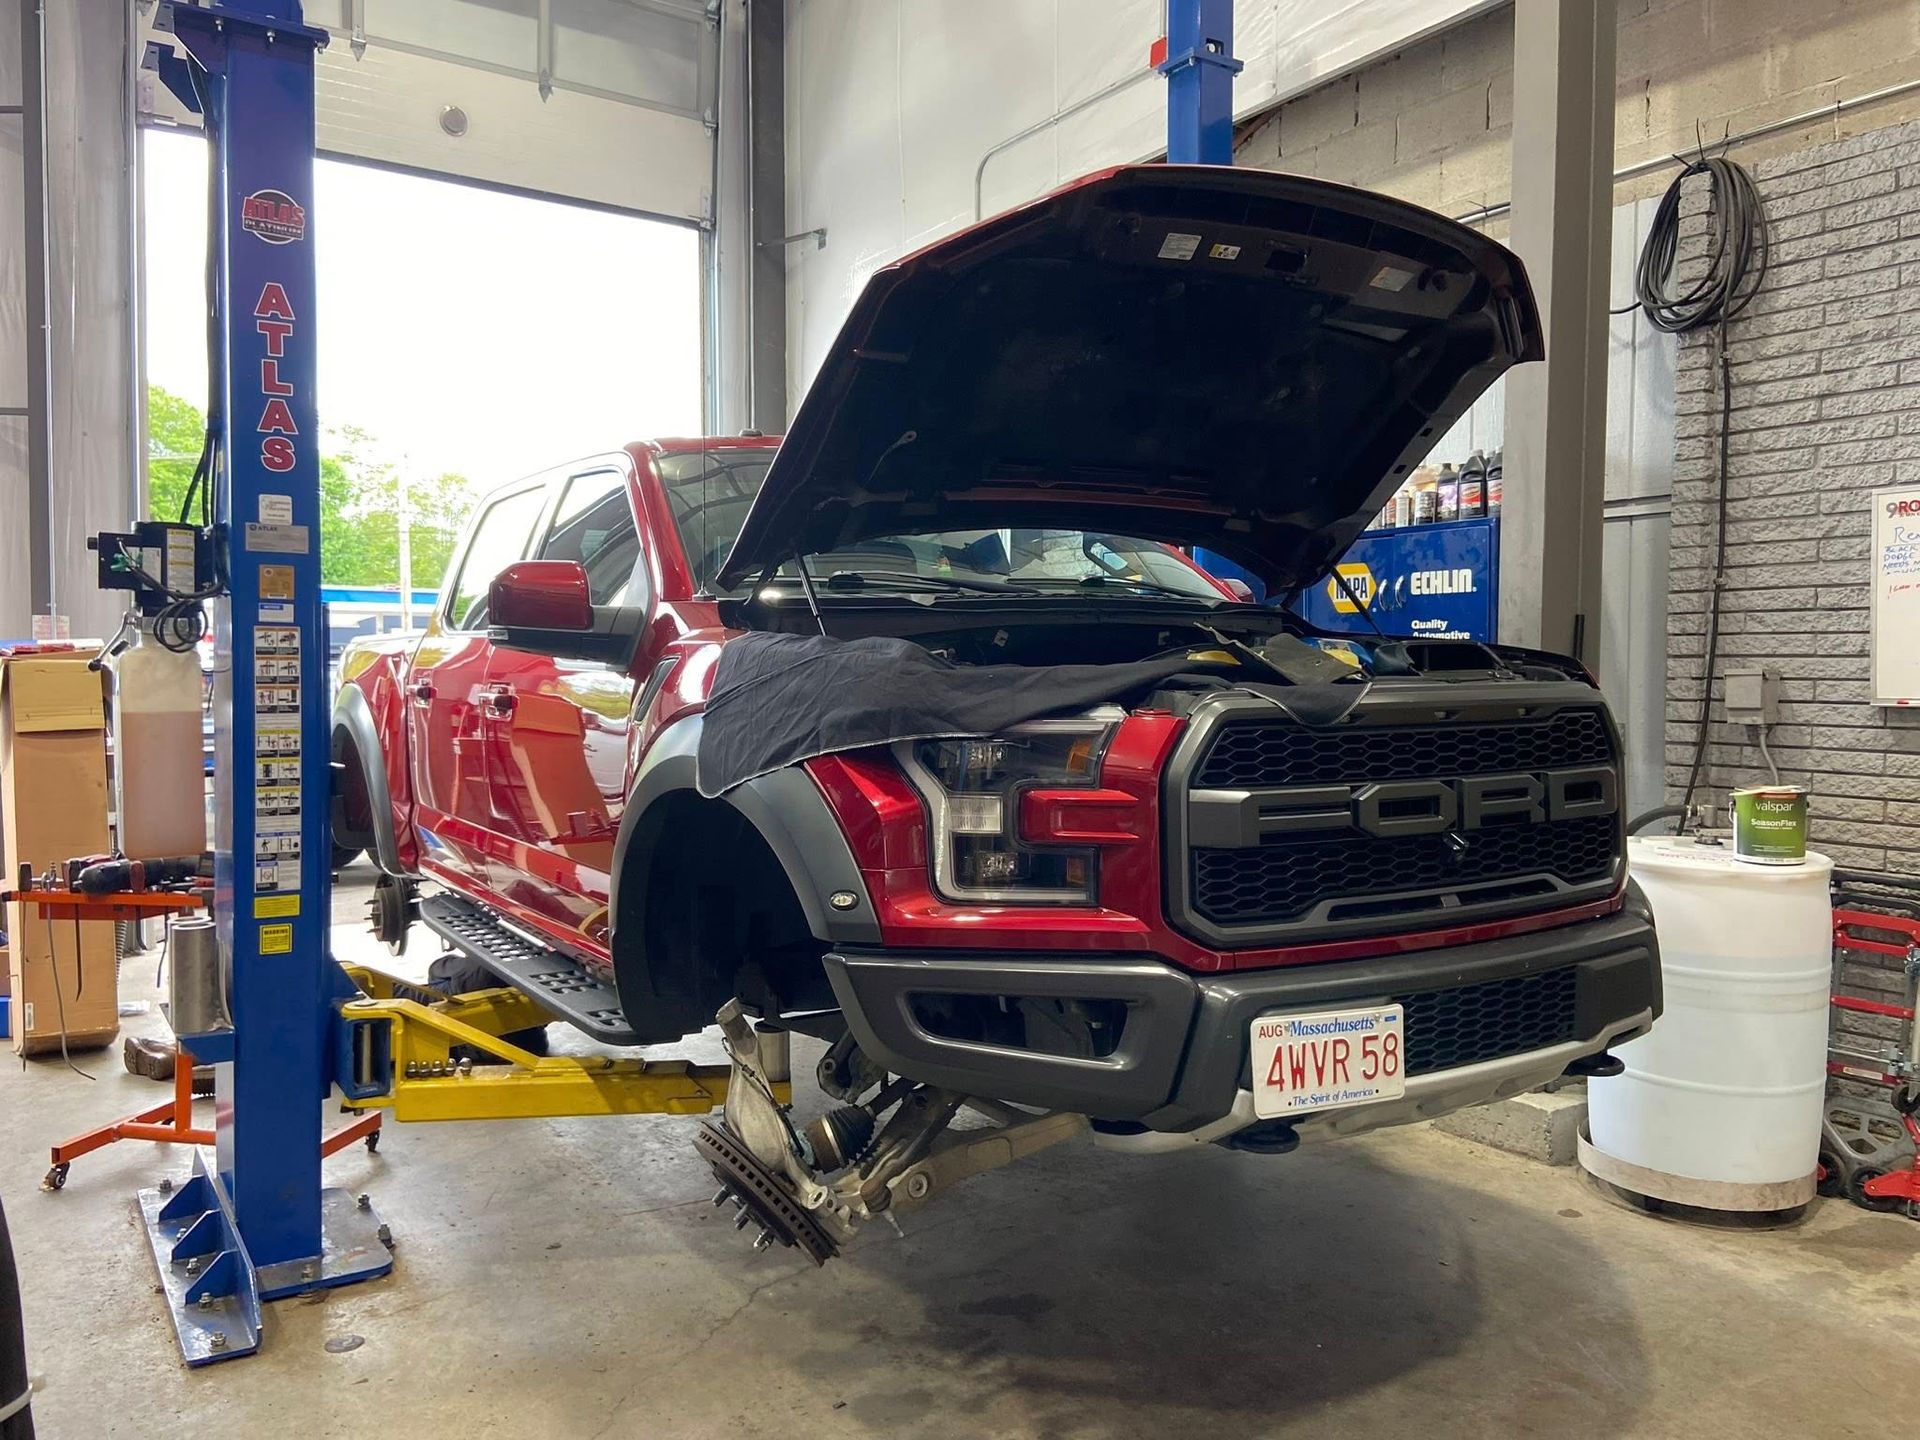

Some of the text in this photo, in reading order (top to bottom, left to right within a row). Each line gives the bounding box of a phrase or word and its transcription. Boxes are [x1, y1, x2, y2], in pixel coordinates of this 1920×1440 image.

[243, 197, 305, 228] ATLAS
[254, 282, 299, 472] ATLAS
[1884, 552, 1916, 562] DODGE
[1411, 619, 1448, 631] Quality
[1189, 767, 1619, 848] FORD
[1755, 801, 1794, 813] valspar
[1751, 818, 1797, 826] SeasonFlex
[1258, 1017, 1375, 1038] AUG Massachusetts
[1266, 1032, 1398, 1093] 4WVR 58
[1292, 1088, 1374, 1107] The Spirit of America
